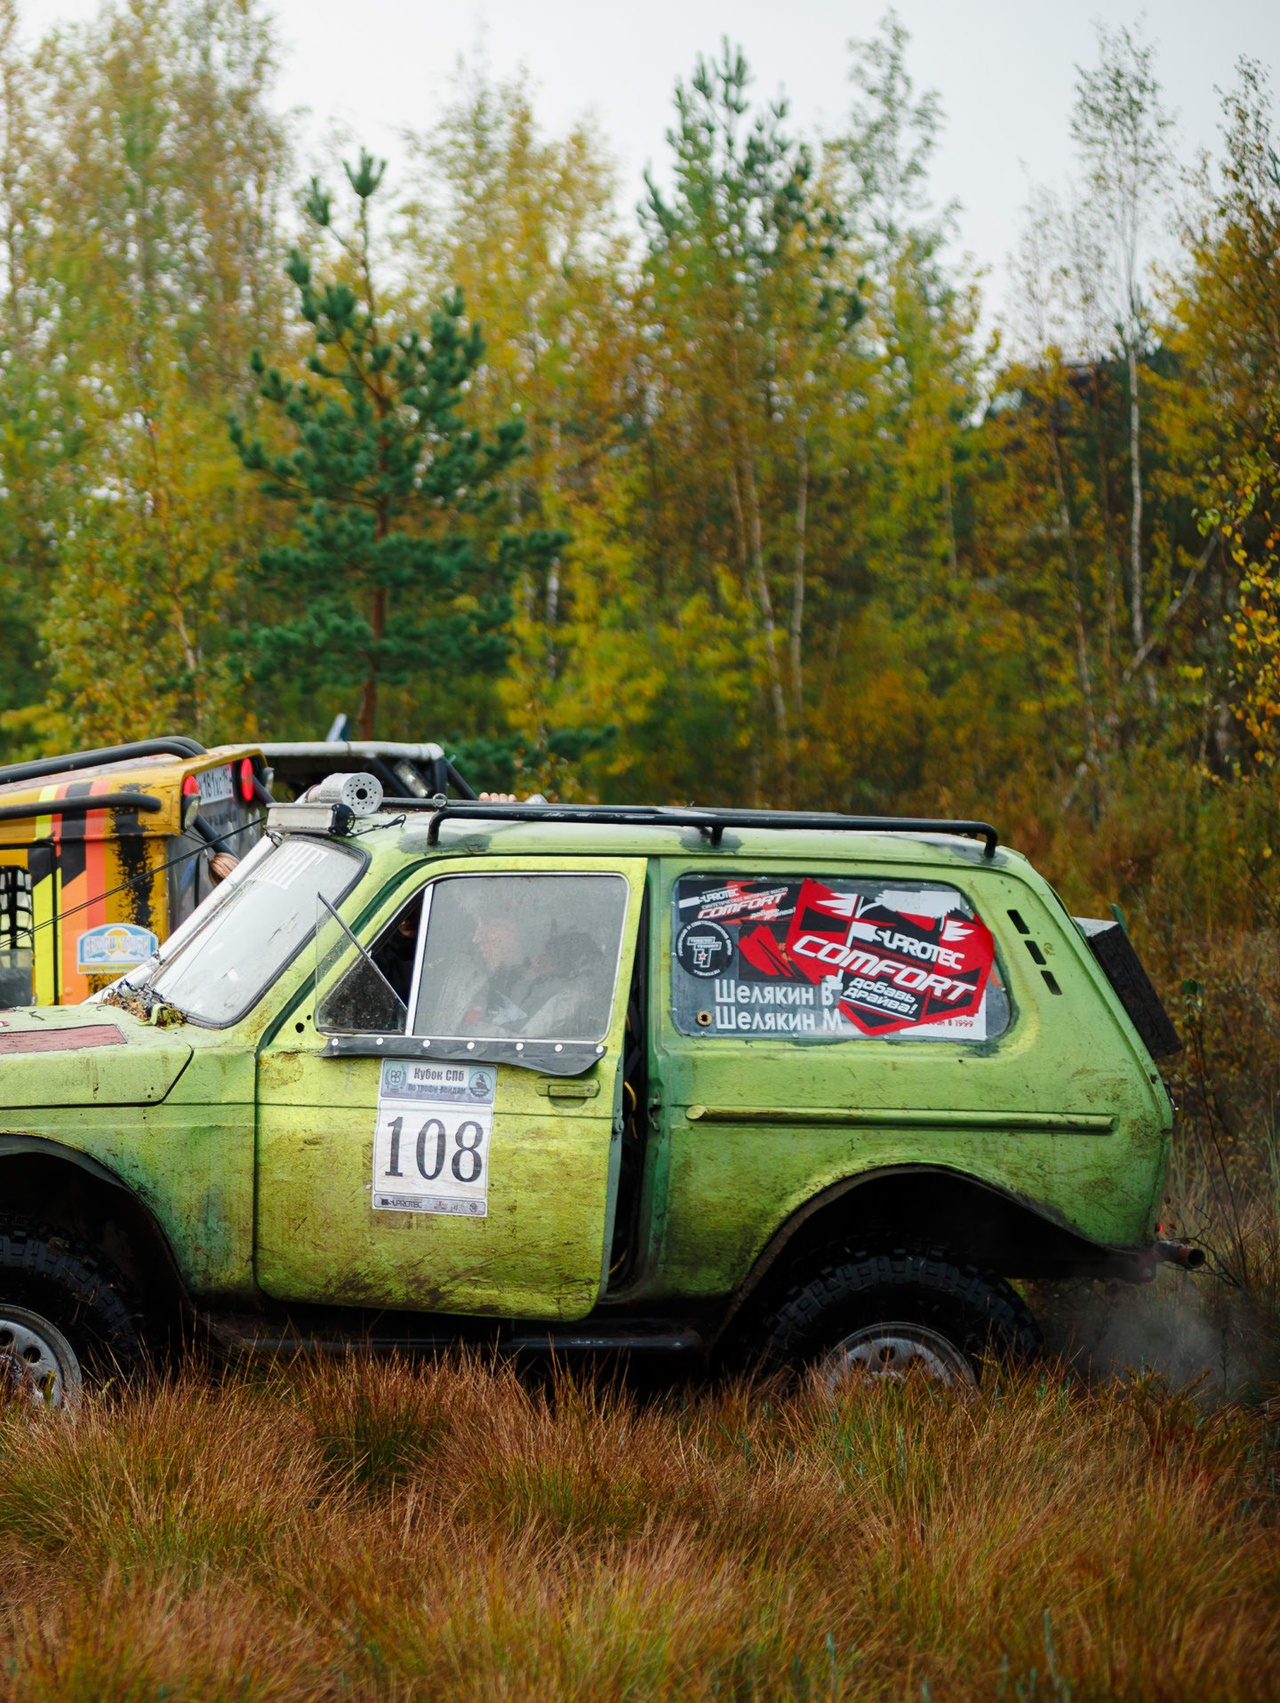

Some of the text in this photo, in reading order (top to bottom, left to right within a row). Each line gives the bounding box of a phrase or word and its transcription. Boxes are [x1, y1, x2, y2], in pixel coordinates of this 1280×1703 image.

[697, 892, 788, 919] COMFORT
[874, 929, 965, 970] SUPROTEC
[792, 934, 978, 1002] COMFORT
[715, 979, 814, 1005] Шелякин
[843, 986, 918, 1015] драйва!
[849, 977, 916, 1004] добавь
[716, 1005, 842, 1031] Шелякин М
[414, 1067, 465, 1082] Кубок СПб
[385, 1116, 483, 1183] 108
